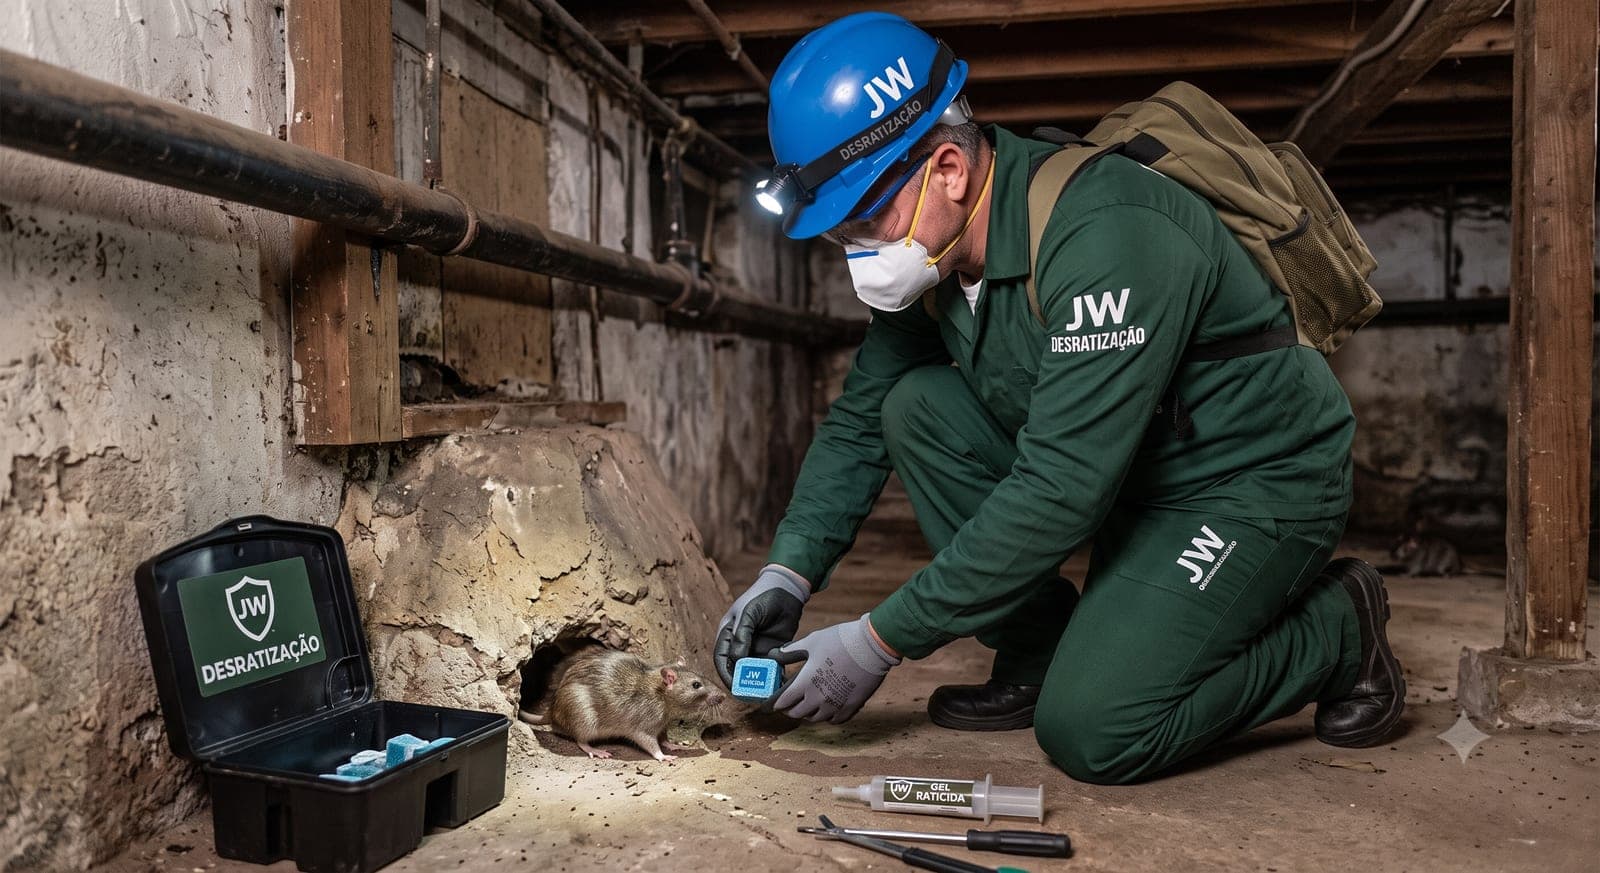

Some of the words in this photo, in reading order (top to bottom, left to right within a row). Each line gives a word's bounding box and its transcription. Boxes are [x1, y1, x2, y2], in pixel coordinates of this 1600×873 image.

[863, 56, 915, 119] JW
[840, 100, 922, 160] DESRATIZAÇÃO
[1066, 287, 1131, 331] JW
[1051, 325, 1145, 353] DESRATIZAÇÃO
[1176, 524, 1225, 584] JW
[238, 594, 267, 620] JW
[201, 633, 320, 685] DESRATIZAÇÃO
[746, 670, 761, 680] JW
[894, 783, 909, 793] JW
[916, 791, 966, 803] RATICIDA
[930, 783, 951, 792] GEL
